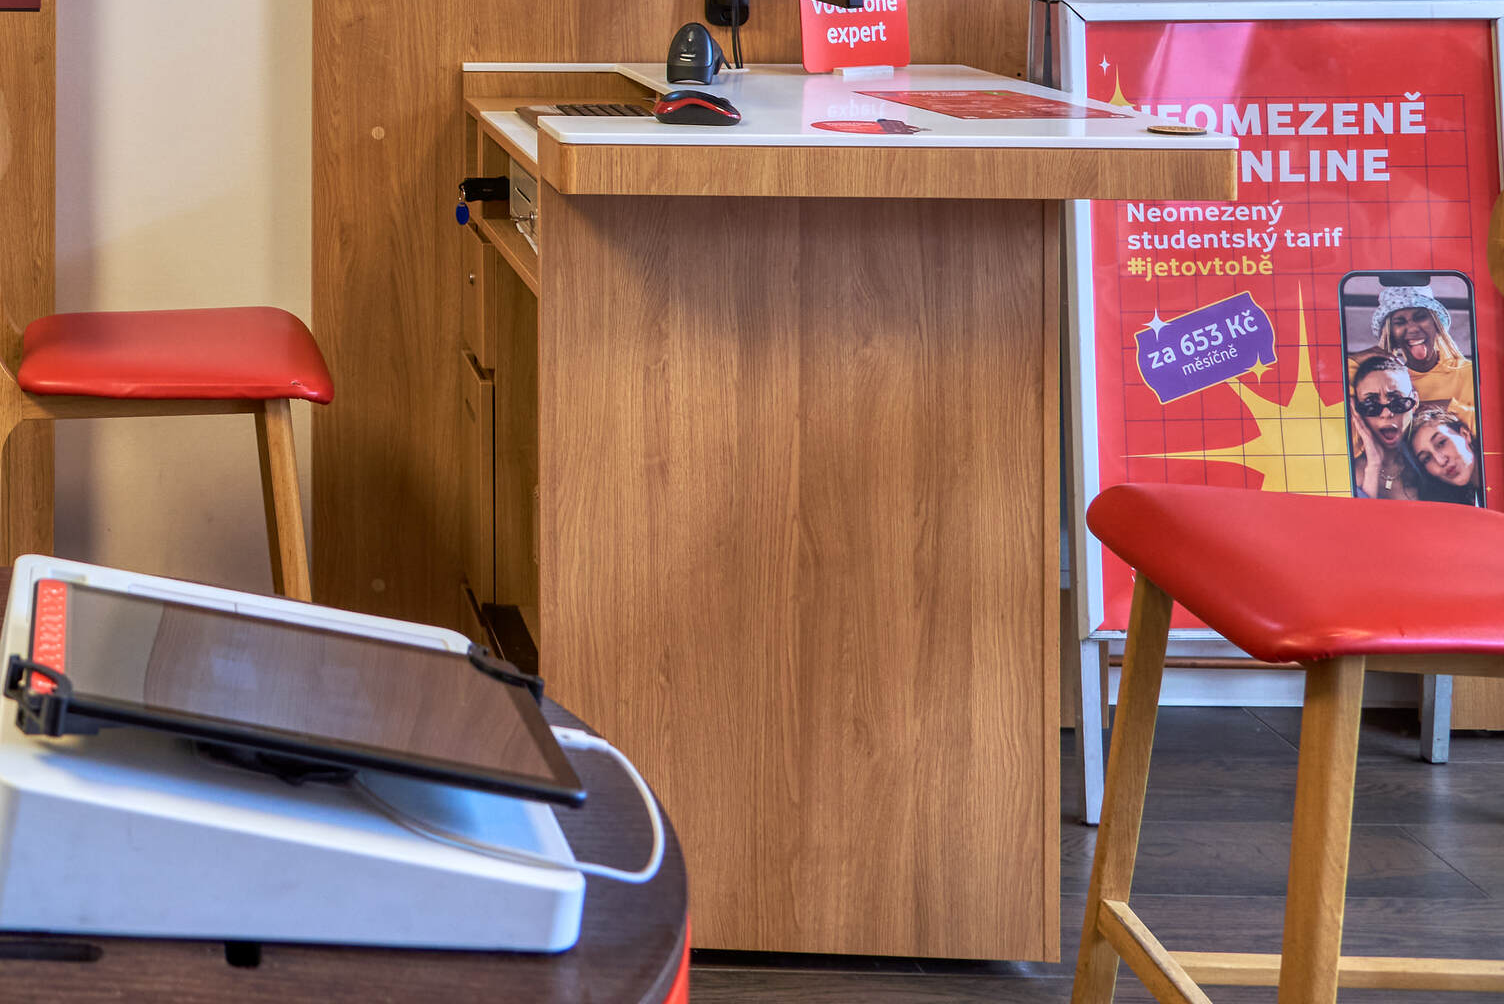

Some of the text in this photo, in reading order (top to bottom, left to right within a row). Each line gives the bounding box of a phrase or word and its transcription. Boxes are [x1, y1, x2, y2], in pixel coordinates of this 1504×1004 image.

[827, 22, 886, 48] expert
[1126, 92, 1427, 135] EOMEZENĚ
[1242, 149, 1390, 182] NLINE
[1127, 199, 1283, 225] Neomezený
[1127, 227, 1343, 252] studentský tarif
[1127, 254, 1273, 281] #jetovtobě
[1148, 309, 1258, 369] za 653 Kč
[1182, 344, 1238, 376] měsíčně
